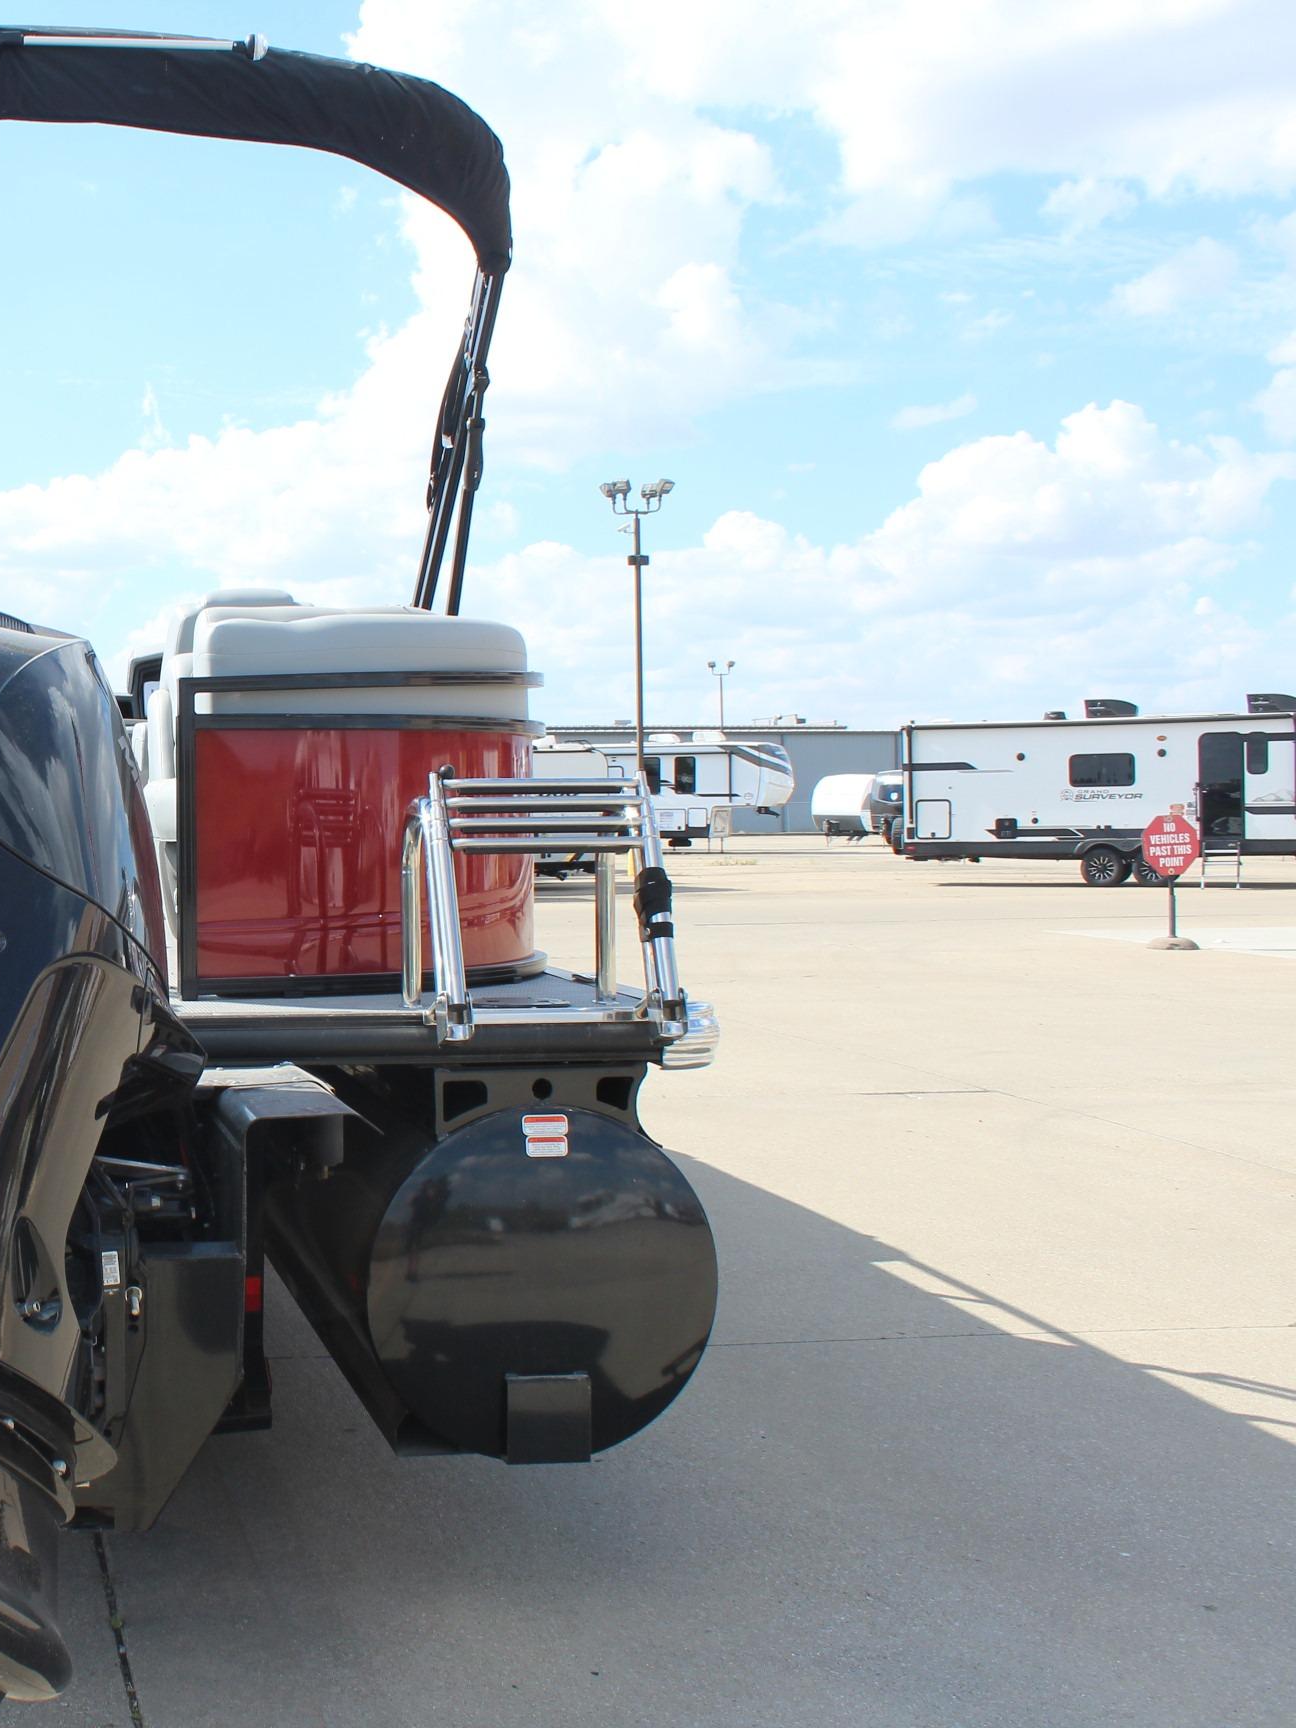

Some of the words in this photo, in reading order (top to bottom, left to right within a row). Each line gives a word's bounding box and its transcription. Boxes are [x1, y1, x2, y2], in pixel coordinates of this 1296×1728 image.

[1162, 822, 1176, 832] NO
[1149, 833, 1190, 845] VEHICLES
[1149, 845, 1171, 857] PAST
[1173, 844, 1192, 855] THIS
[1159, 856, 1184, 867] POINT
